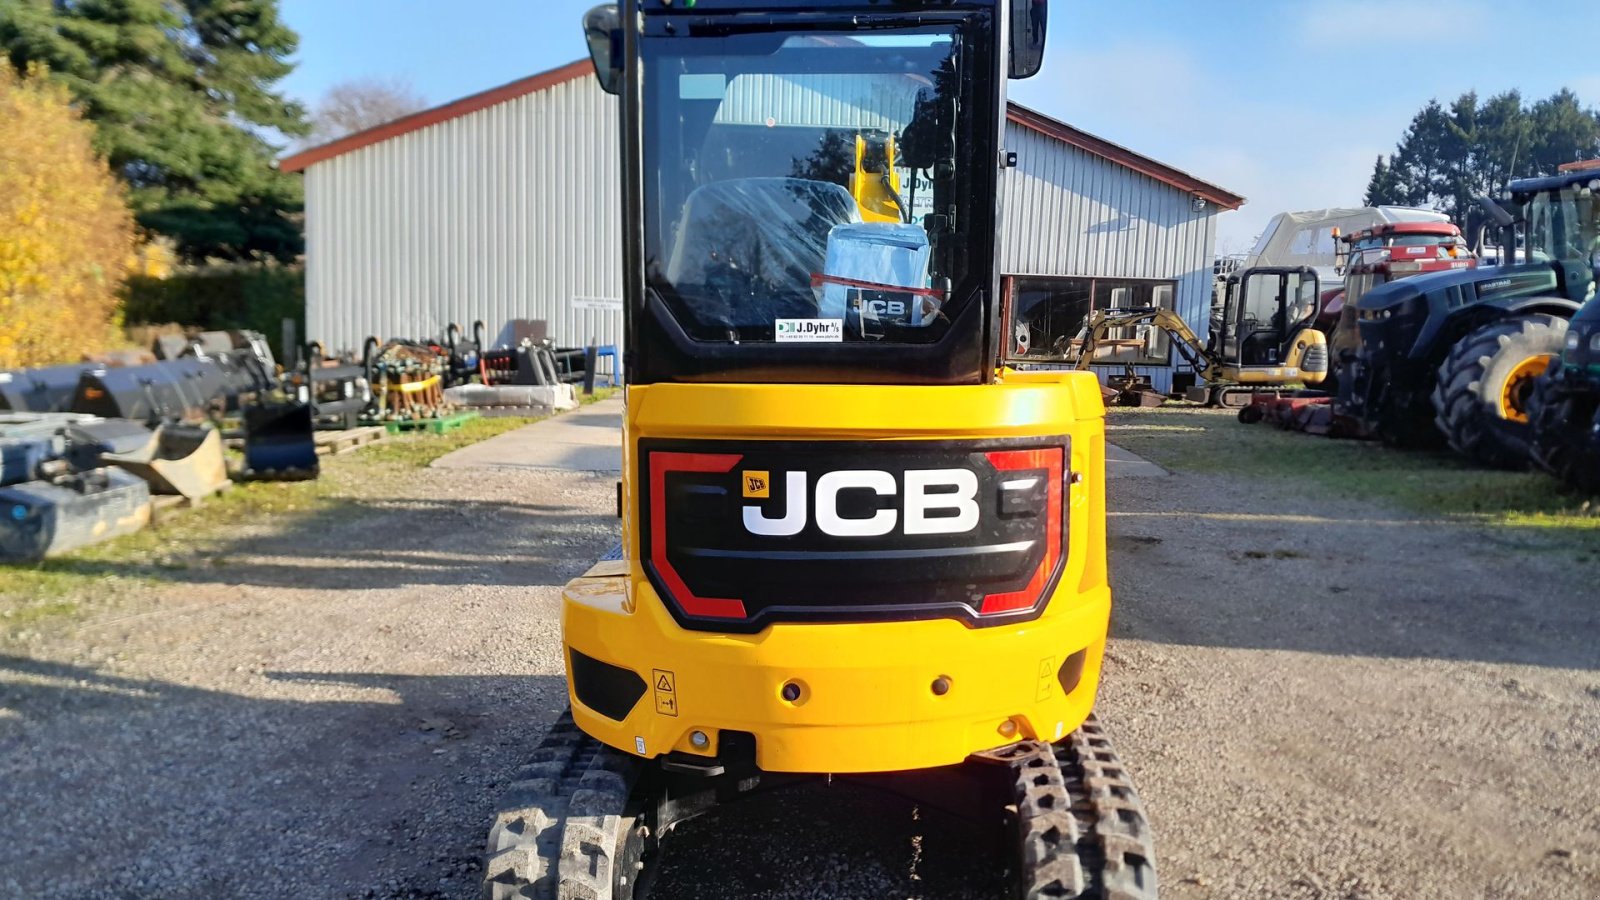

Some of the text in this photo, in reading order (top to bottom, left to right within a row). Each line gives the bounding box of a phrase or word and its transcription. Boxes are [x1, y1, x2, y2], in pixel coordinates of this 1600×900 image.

[853, 299, 905, 315] JCB
[796, 322, 830, 335] J.Dyhr
[749, 478, 765, 491] JCB
[742, 468, 980, 536] JCB
